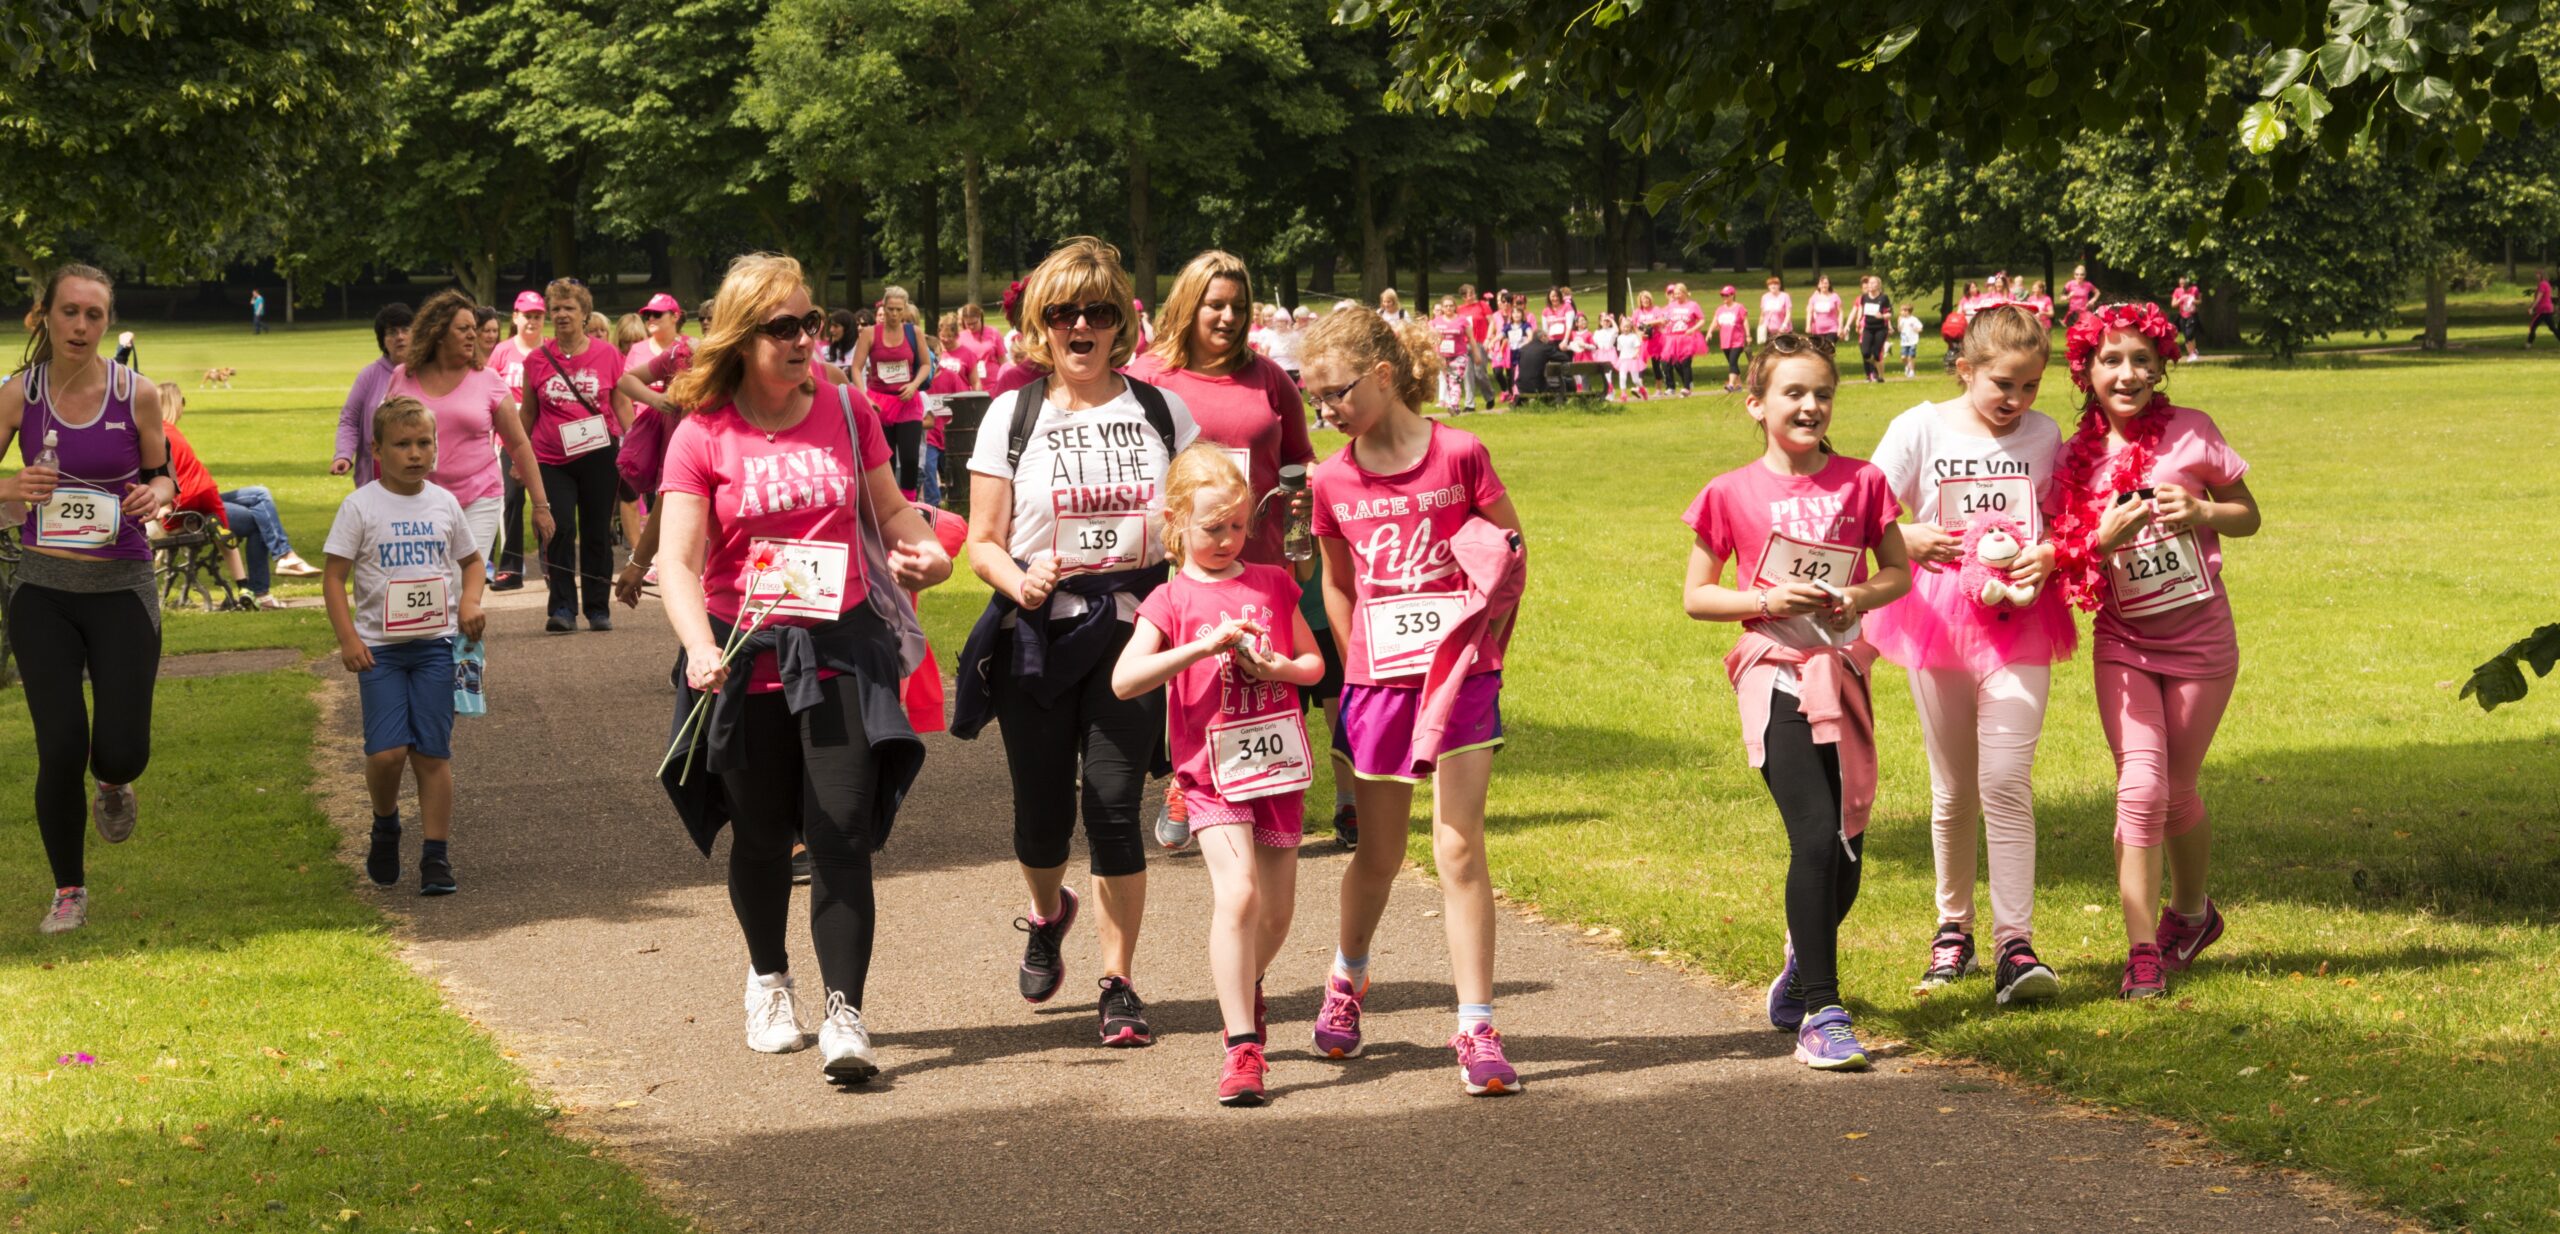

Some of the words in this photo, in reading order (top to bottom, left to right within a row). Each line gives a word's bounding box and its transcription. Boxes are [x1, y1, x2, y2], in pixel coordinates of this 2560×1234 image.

[550, 381, 593, 394] RCE
[580, 427, 587, 437] 2
[1047, 425, 1092, 451] SEE
[1097, 422, 1145, 449] YOU
[742, 447, 840, 484] PINK
[1051, 450, 1088, 487] AT
[1096, 449, 1154, 483] THE
[60, 502, 95, 519] 293
[736, 476, 848, 518] ARMY
[1051, 483, 1155, 521] FINISH
[1332, 495, 1410, 523] RACE
[1417, 484, 1467, 512] FOR
[1769, 493, 1844, 524] PINK
[1963, 492, 2007, 513] 140
[391, 521, 434, 536] TEAM
[1079, 530, 1118, 550] 139
[378, 541, 446, 568] KIRSTY
[1356, 517, 1460, 594] Life
[2125, 551, 2180, 582] 1218
[1789, 558, 1832, 584] 142
[407, 591, 433, 608] 521
[1394, 611, 1441, 636] 339
[1220, 679, 1288, 715] LIFE
[1238, 733, 1284, 761] 340
